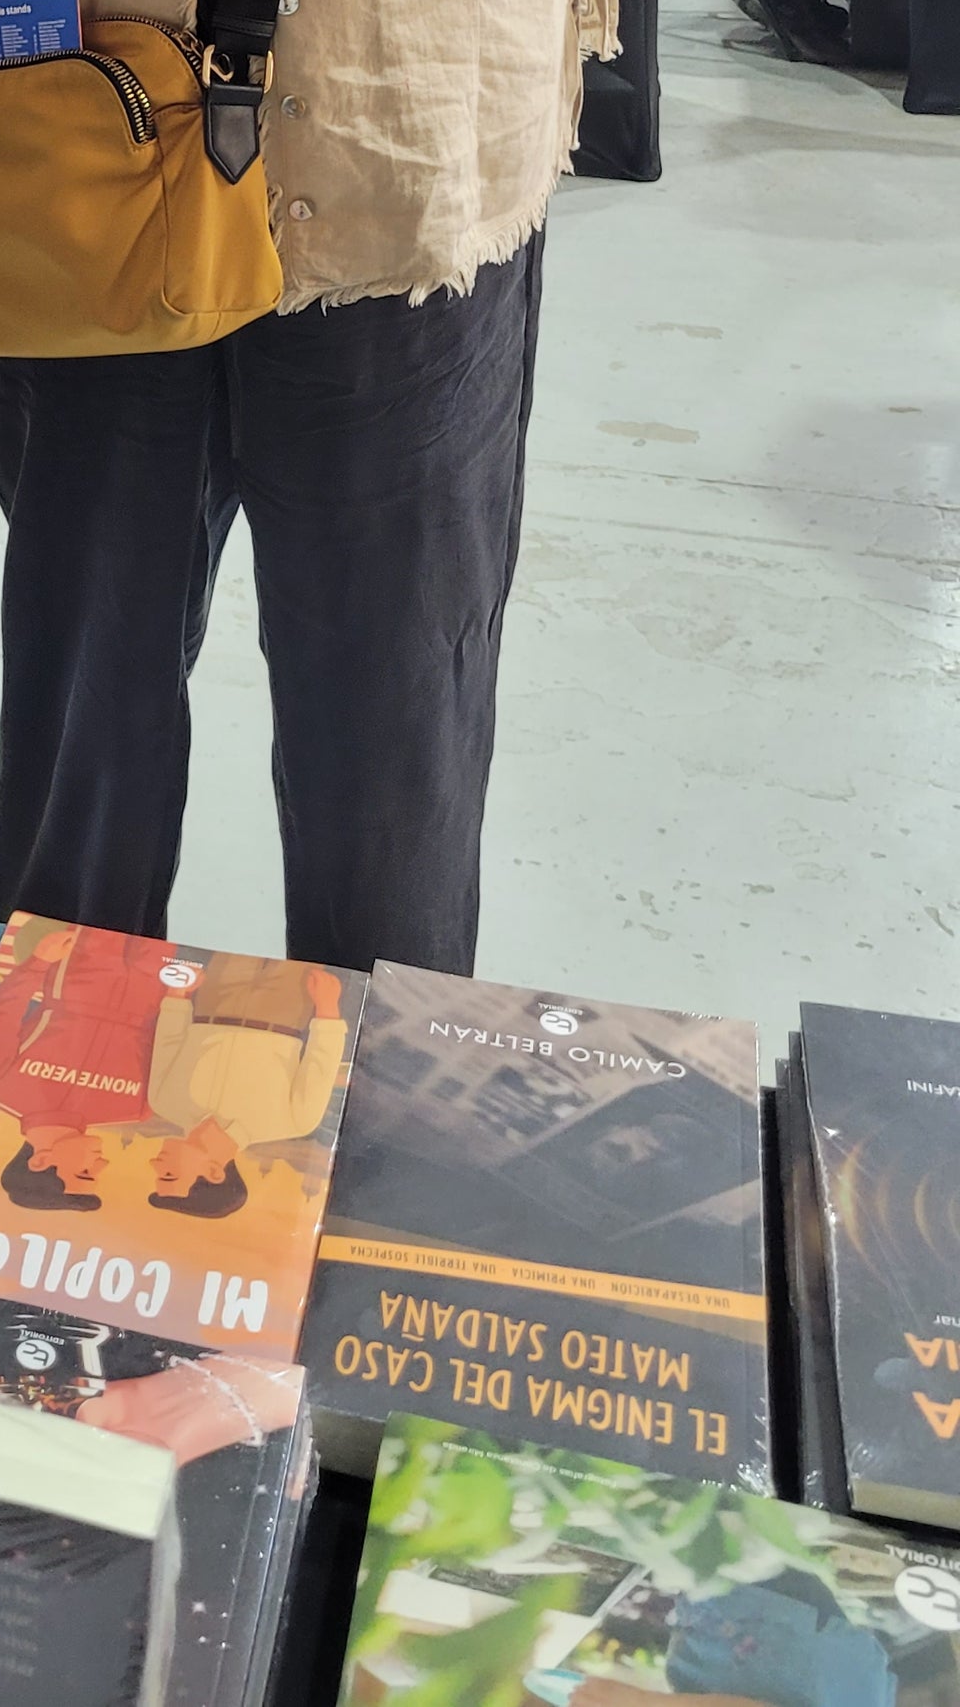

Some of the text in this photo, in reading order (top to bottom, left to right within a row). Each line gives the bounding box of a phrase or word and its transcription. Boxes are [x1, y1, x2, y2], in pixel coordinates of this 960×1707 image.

[162, 956, 203, 969] EDITORIAL
[538, 1002, 583, 1016] EDITORIAL
[429, 1020, 687, 1079] CAMILO BELTRÁN
[19, 1059, 141, 1096] MONTEVERDI
[349, 1245, 409, 1263] SOSPECHA
[415, 1253, 466, 1271] TERRIBLE
[472, 1263, 496, 1275] UNA
[511, 1266, 566, 1286] PRIMICIA
[572, 1276, 596, 1290] UNA
[199, 1270, 268, 1332] MI
[705, 1295, 731, 1310] UNA
[20, 1328, 65, 1346] EDITORIAL
[380, 1289, 691, 1393] MATEO SALDAÑA
[334, 1335, 728, 1457] EL ENIGMA DEL CASO
[442, 1441, 484, 1458] Miranda
[542, 1464, 557, 1475] de
